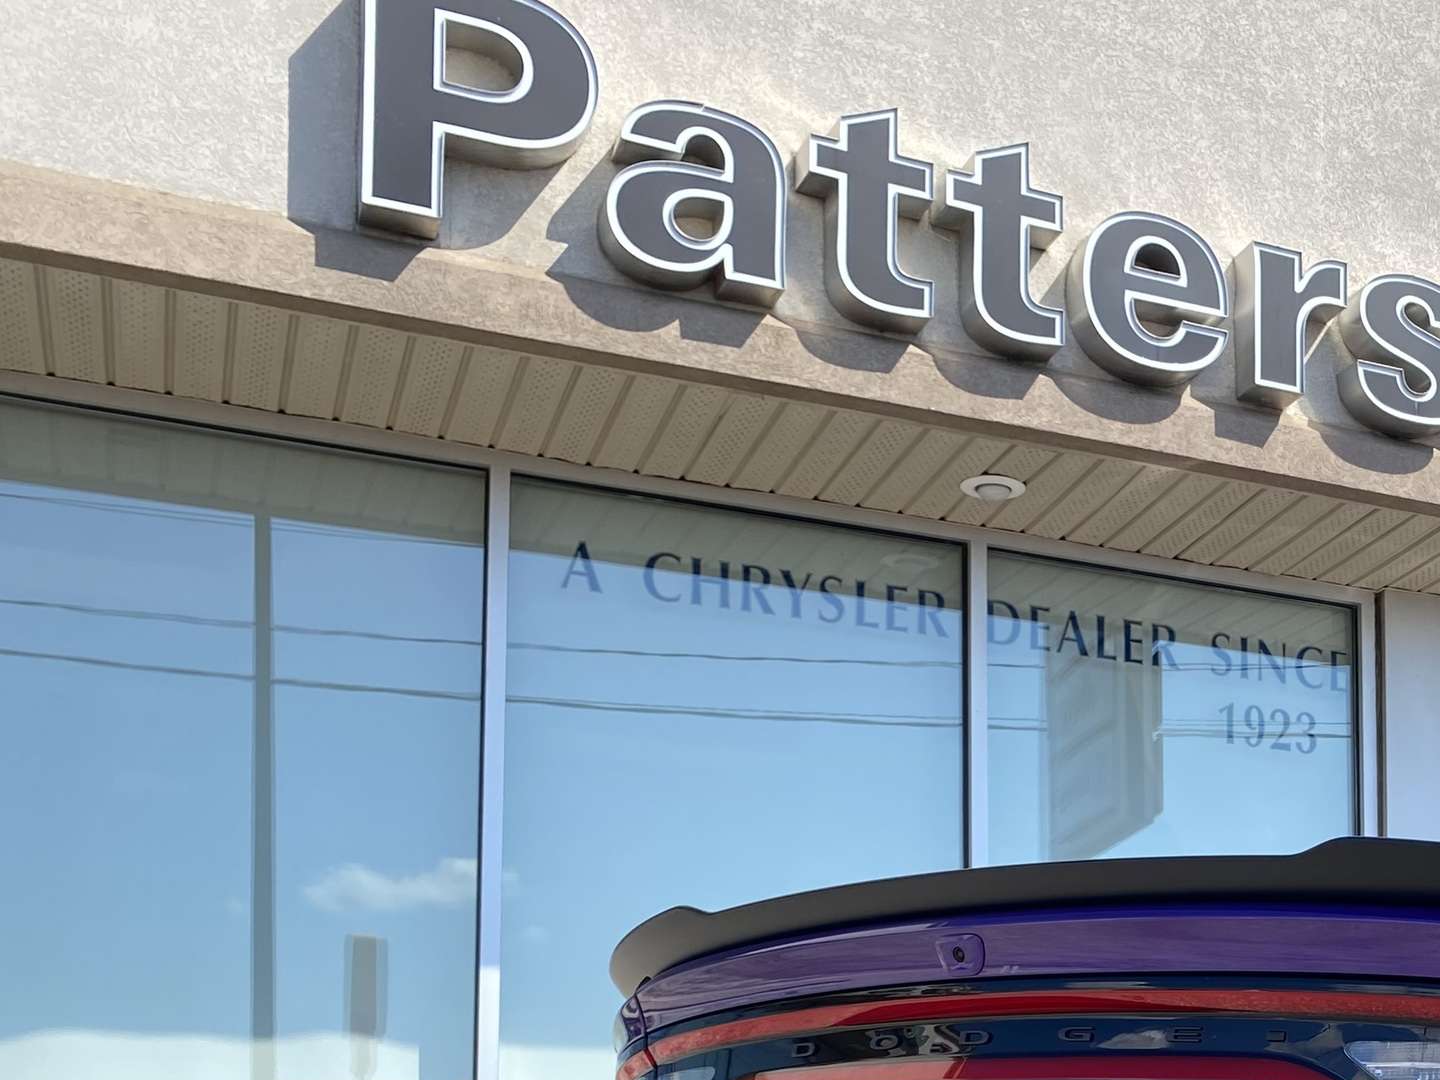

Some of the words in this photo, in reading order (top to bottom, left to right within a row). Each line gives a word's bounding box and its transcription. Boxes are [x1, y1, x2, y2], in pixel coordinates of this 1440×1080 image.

[561, 540, 603, 594] A
[642, 551, 948, 639] CHRYSLER
[987, 599, 1183, 672] DEALER
[1210, 631, 1349, 694] SINCE
[1217, 701, 1318, 755] 1923
[791, 1026, 1204, 1059] DODGE
